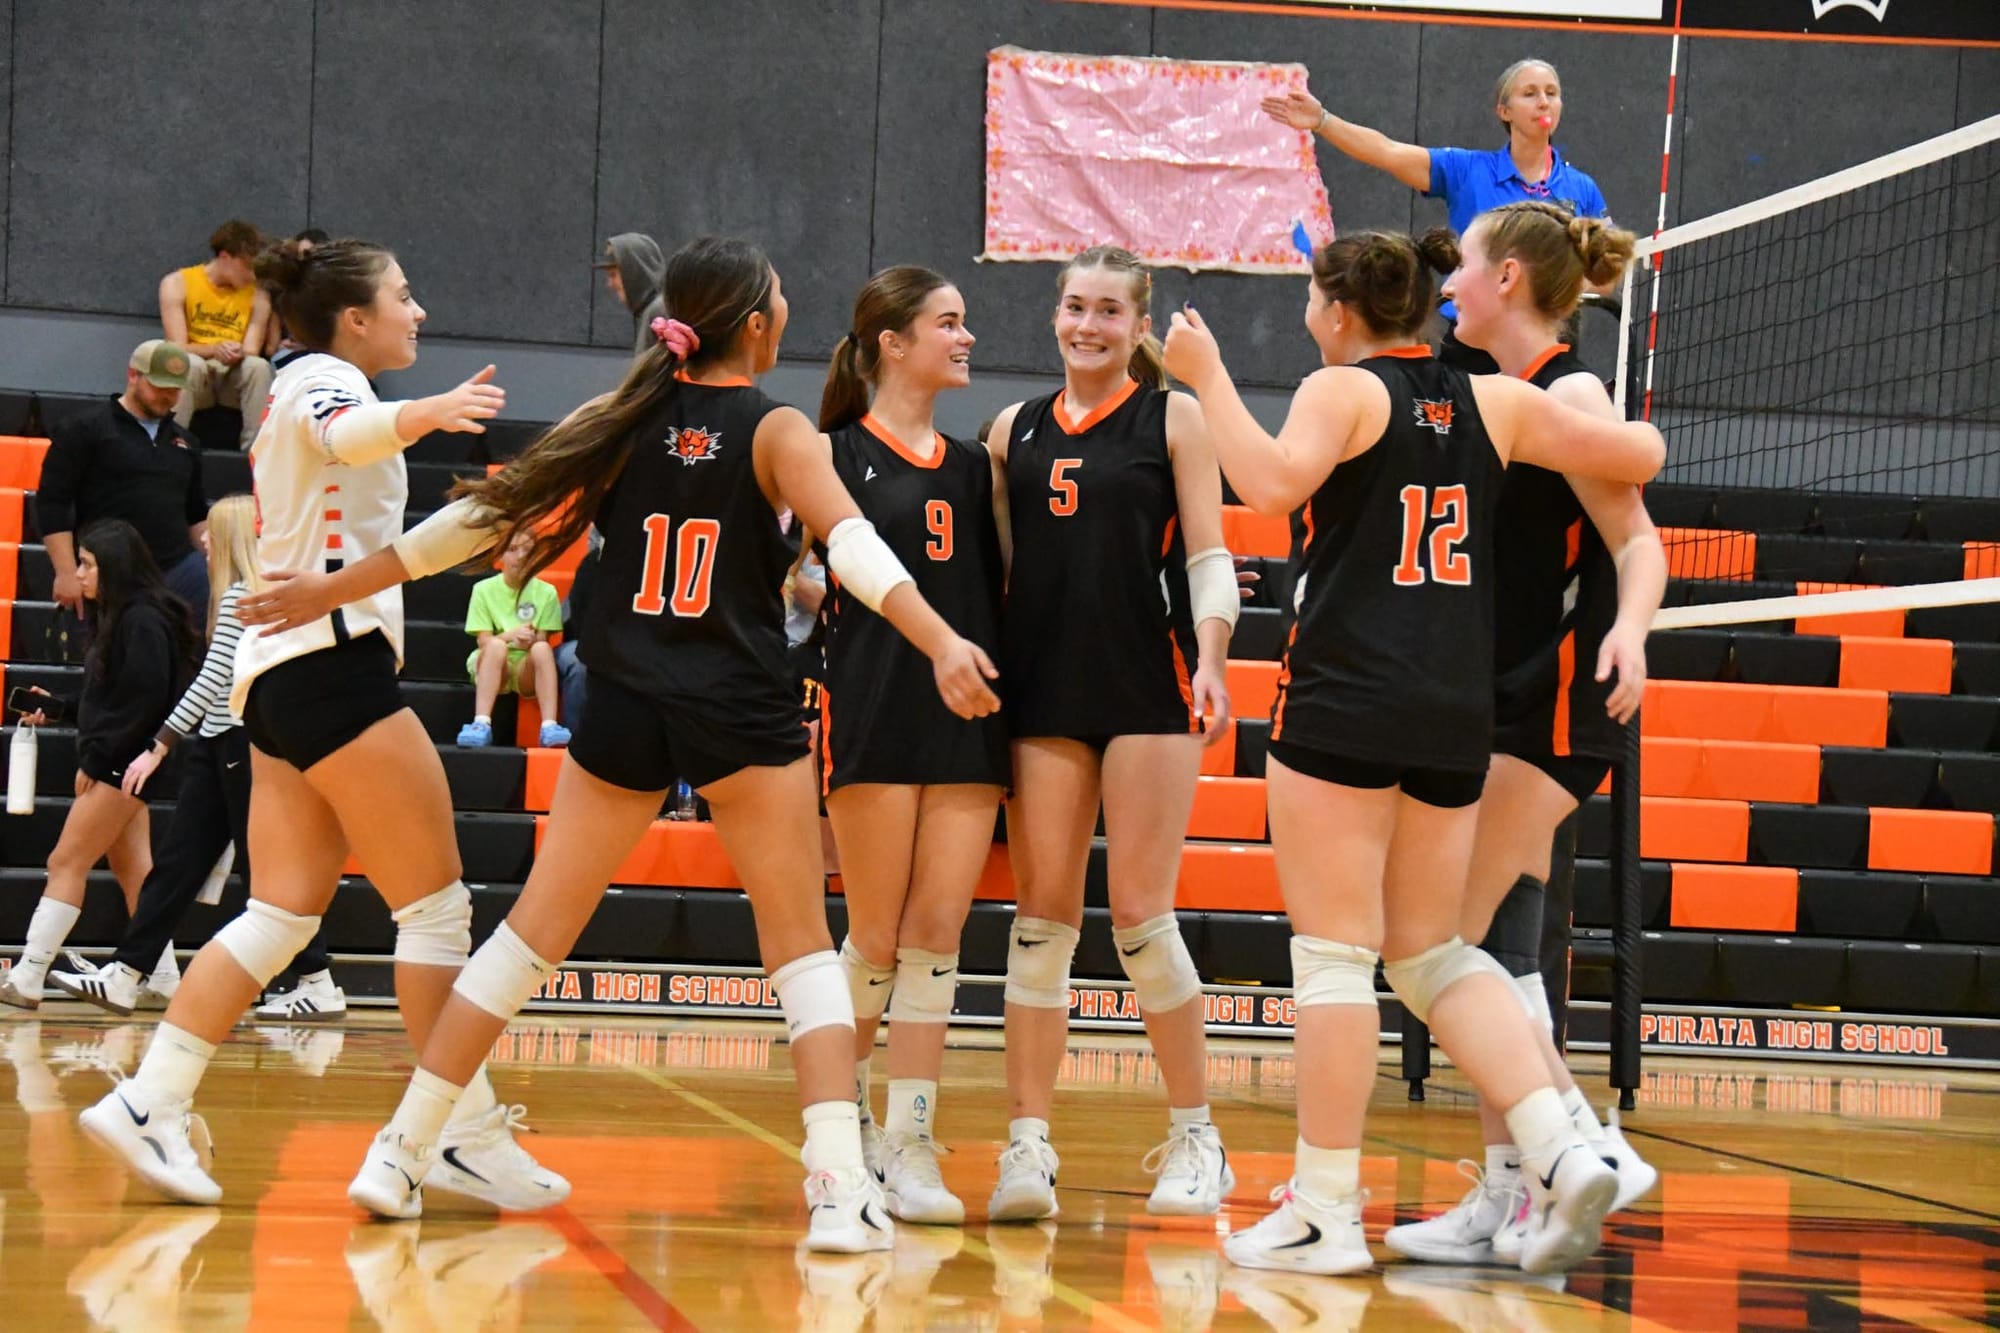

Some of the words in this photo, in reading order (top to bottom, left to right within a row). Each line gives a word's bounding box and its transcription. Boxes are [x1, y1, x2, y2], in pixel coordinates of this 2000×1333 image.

[1048, 458, 1083, 517] 5
[925, 499, 953, 562] 9
[1393, 483, 1471, 586] 12
[632, 513, 721, 618] 10
[592, 971, 661, 1002] HIGH
[669, 974, 778, 1006] SCHOOL
[1068, 988, 1140, 1019] PHRA
[1639, 1013, 1757, 1046] PHRATA
[1766, 1018, 1832, 1050] HIGH
[1840, 1023, 1948, 1055] SCHOOL
